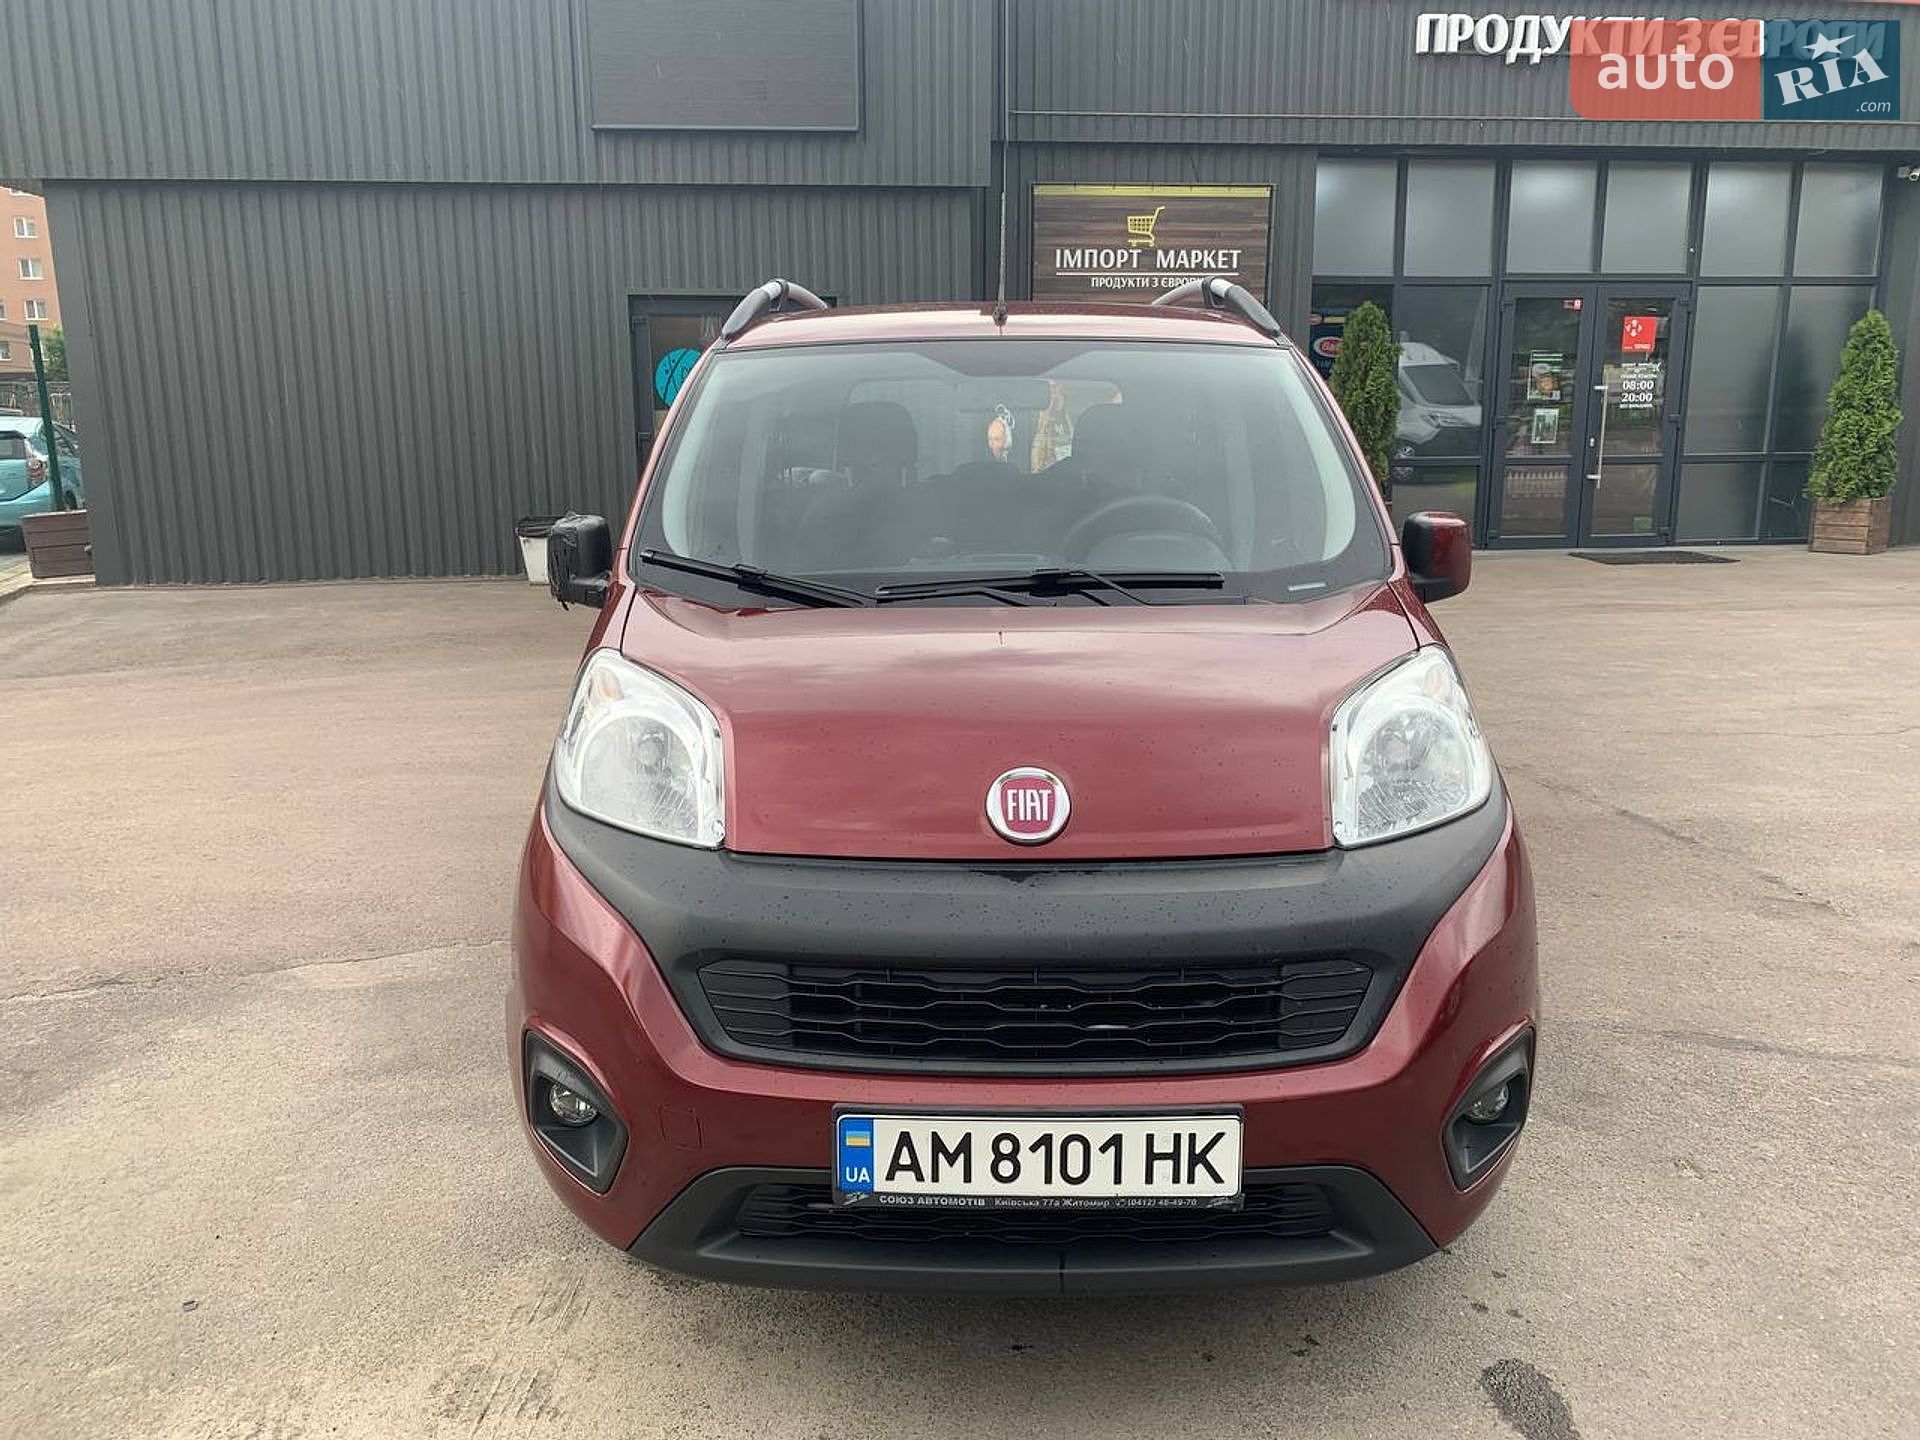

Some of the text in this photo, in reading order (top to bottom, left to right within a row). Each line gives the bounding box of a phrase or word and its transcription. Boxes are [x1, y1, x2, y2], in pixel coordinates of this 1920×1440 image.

[1415, 13, 1887, 64] ПРОДУКТИ З ЄВРОПИ
[1055, 249, 1242, 270] ІМПОРТ МАРКЕТ
[1091, 277, 1205, 289] ПРОДУКТИ З ЄВРО
[1622, 380, 1655, 391] 08:00
[1621, 392, 1654, 403] 20:00
[1007, 788, 1052, 821] FIAT
[884, 1131, 1226, 1185] AM 8101 HK
[845, 1167, 870, 1183] UA
[878, 1195, 915, 1205] СОЮЗ
